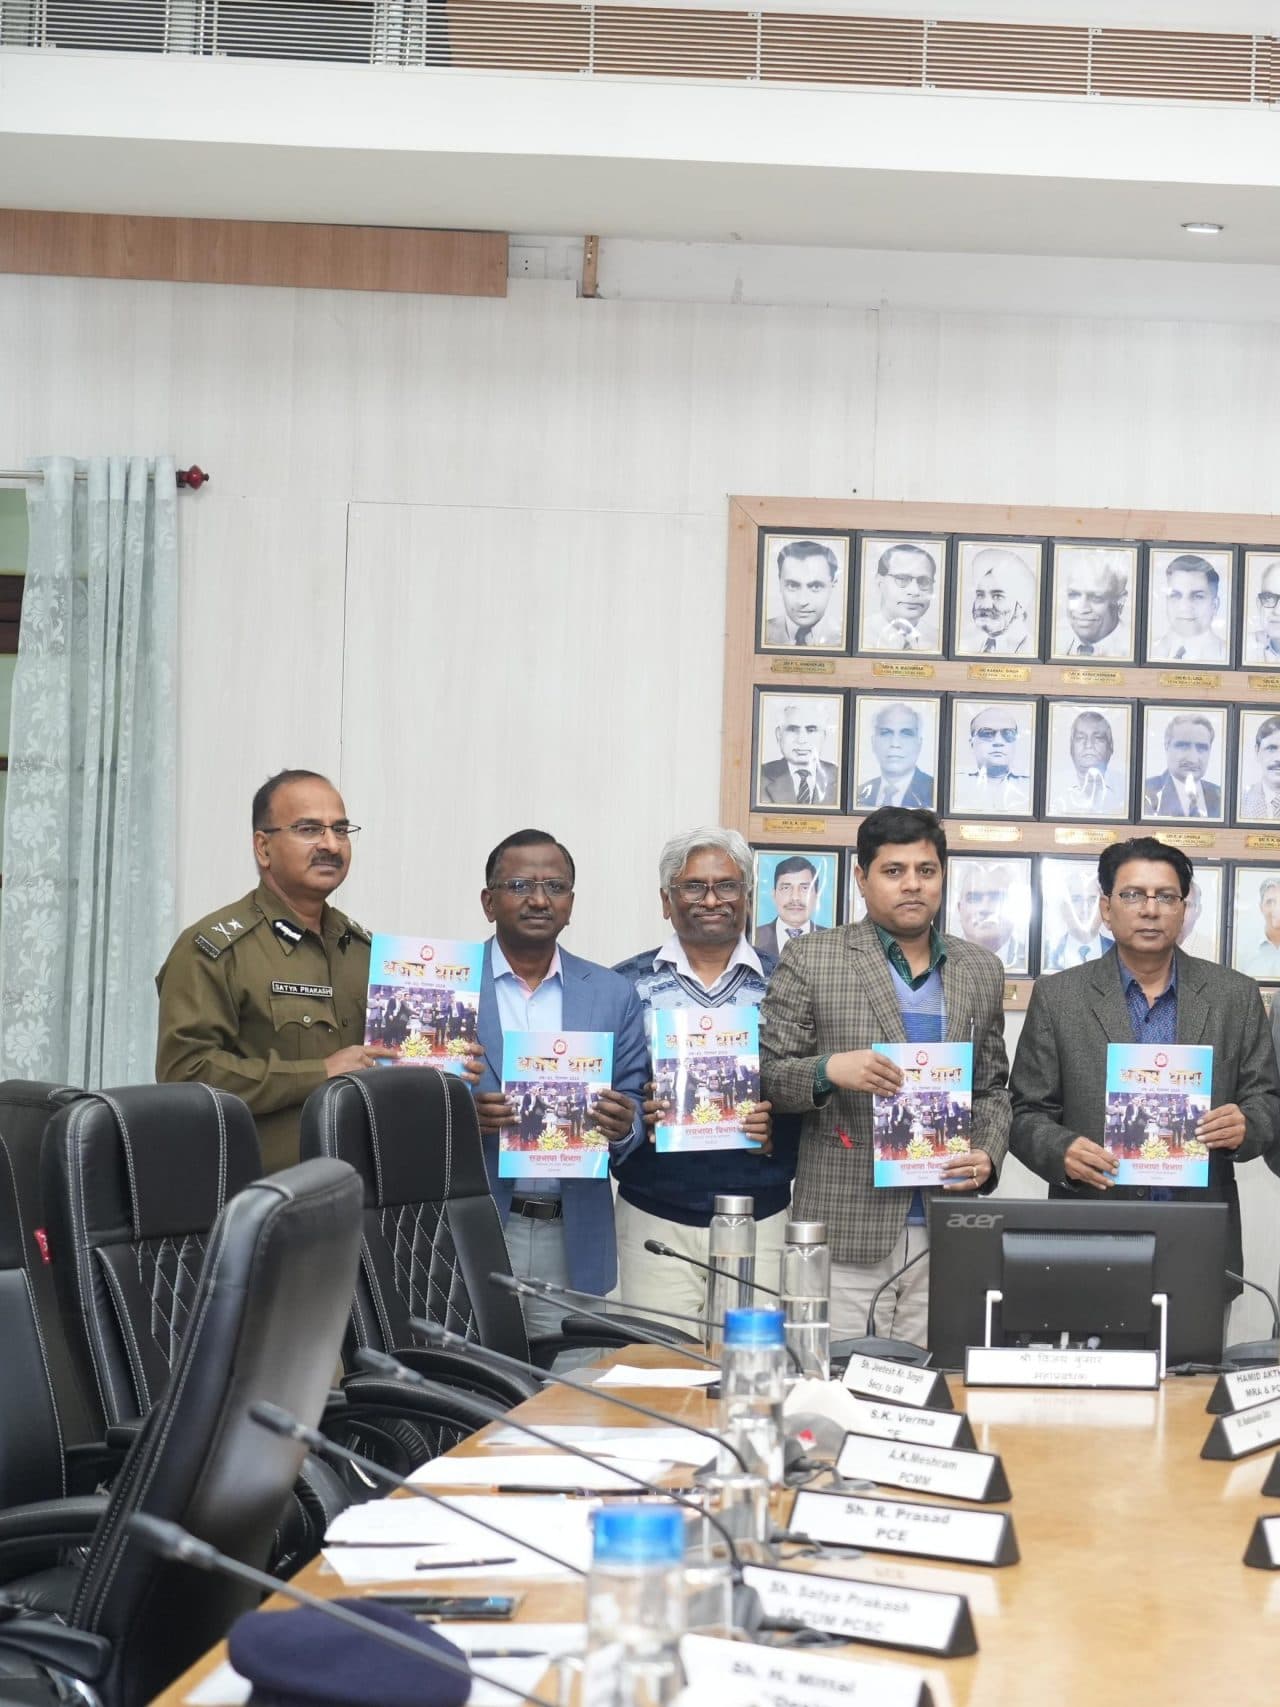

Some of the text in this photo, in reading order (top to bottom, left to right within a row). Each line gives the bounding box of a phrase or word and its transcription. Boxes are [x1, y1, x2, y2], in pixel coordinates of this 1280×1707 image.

[946, 1213, 1004, 1229] acer
[1236, 1373, 1261, 1383] HAMID
[899, 1413, 935, 1426] Verma
[899, 1471, 932, 1486] PCMM
[845, 1503, 950, 1524] Sh. R. Prasad
[875, 1527, 907, 1542] PCE
[769, 1579, 911, 1613] Sh. Satya Prakash
